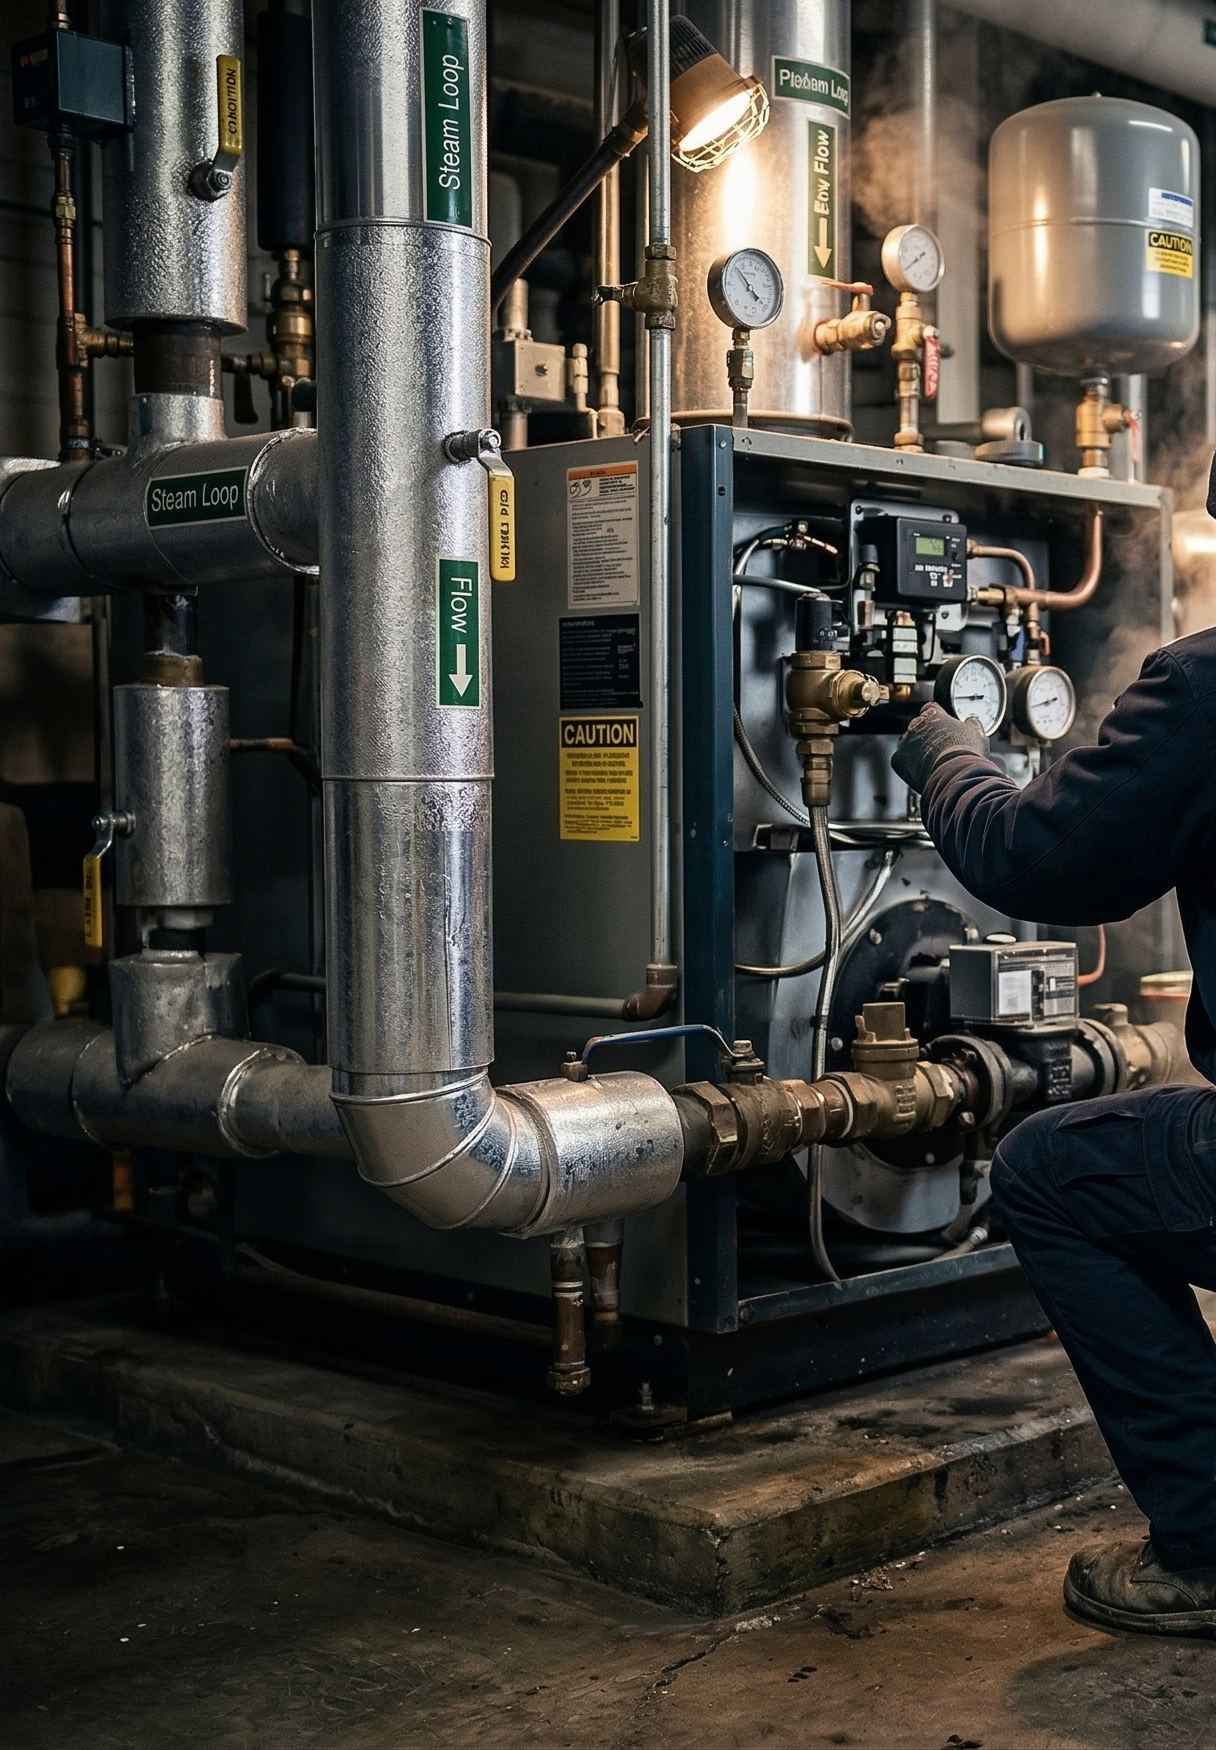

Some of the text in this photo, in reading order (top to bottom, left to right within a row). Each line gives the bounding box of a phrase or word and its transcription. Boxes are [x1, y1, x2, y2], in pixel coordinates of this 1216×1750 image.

[438, 54, 465, 190] Steam Loop
[813, 129, 830, 175] Flow
[1150, 233, 1192, 254] CAUTION
[151, 482, 239, 512] Steam Loop
[450, 577, 473, 634] Flow
[564, 723, 635, 745] CAUTION
